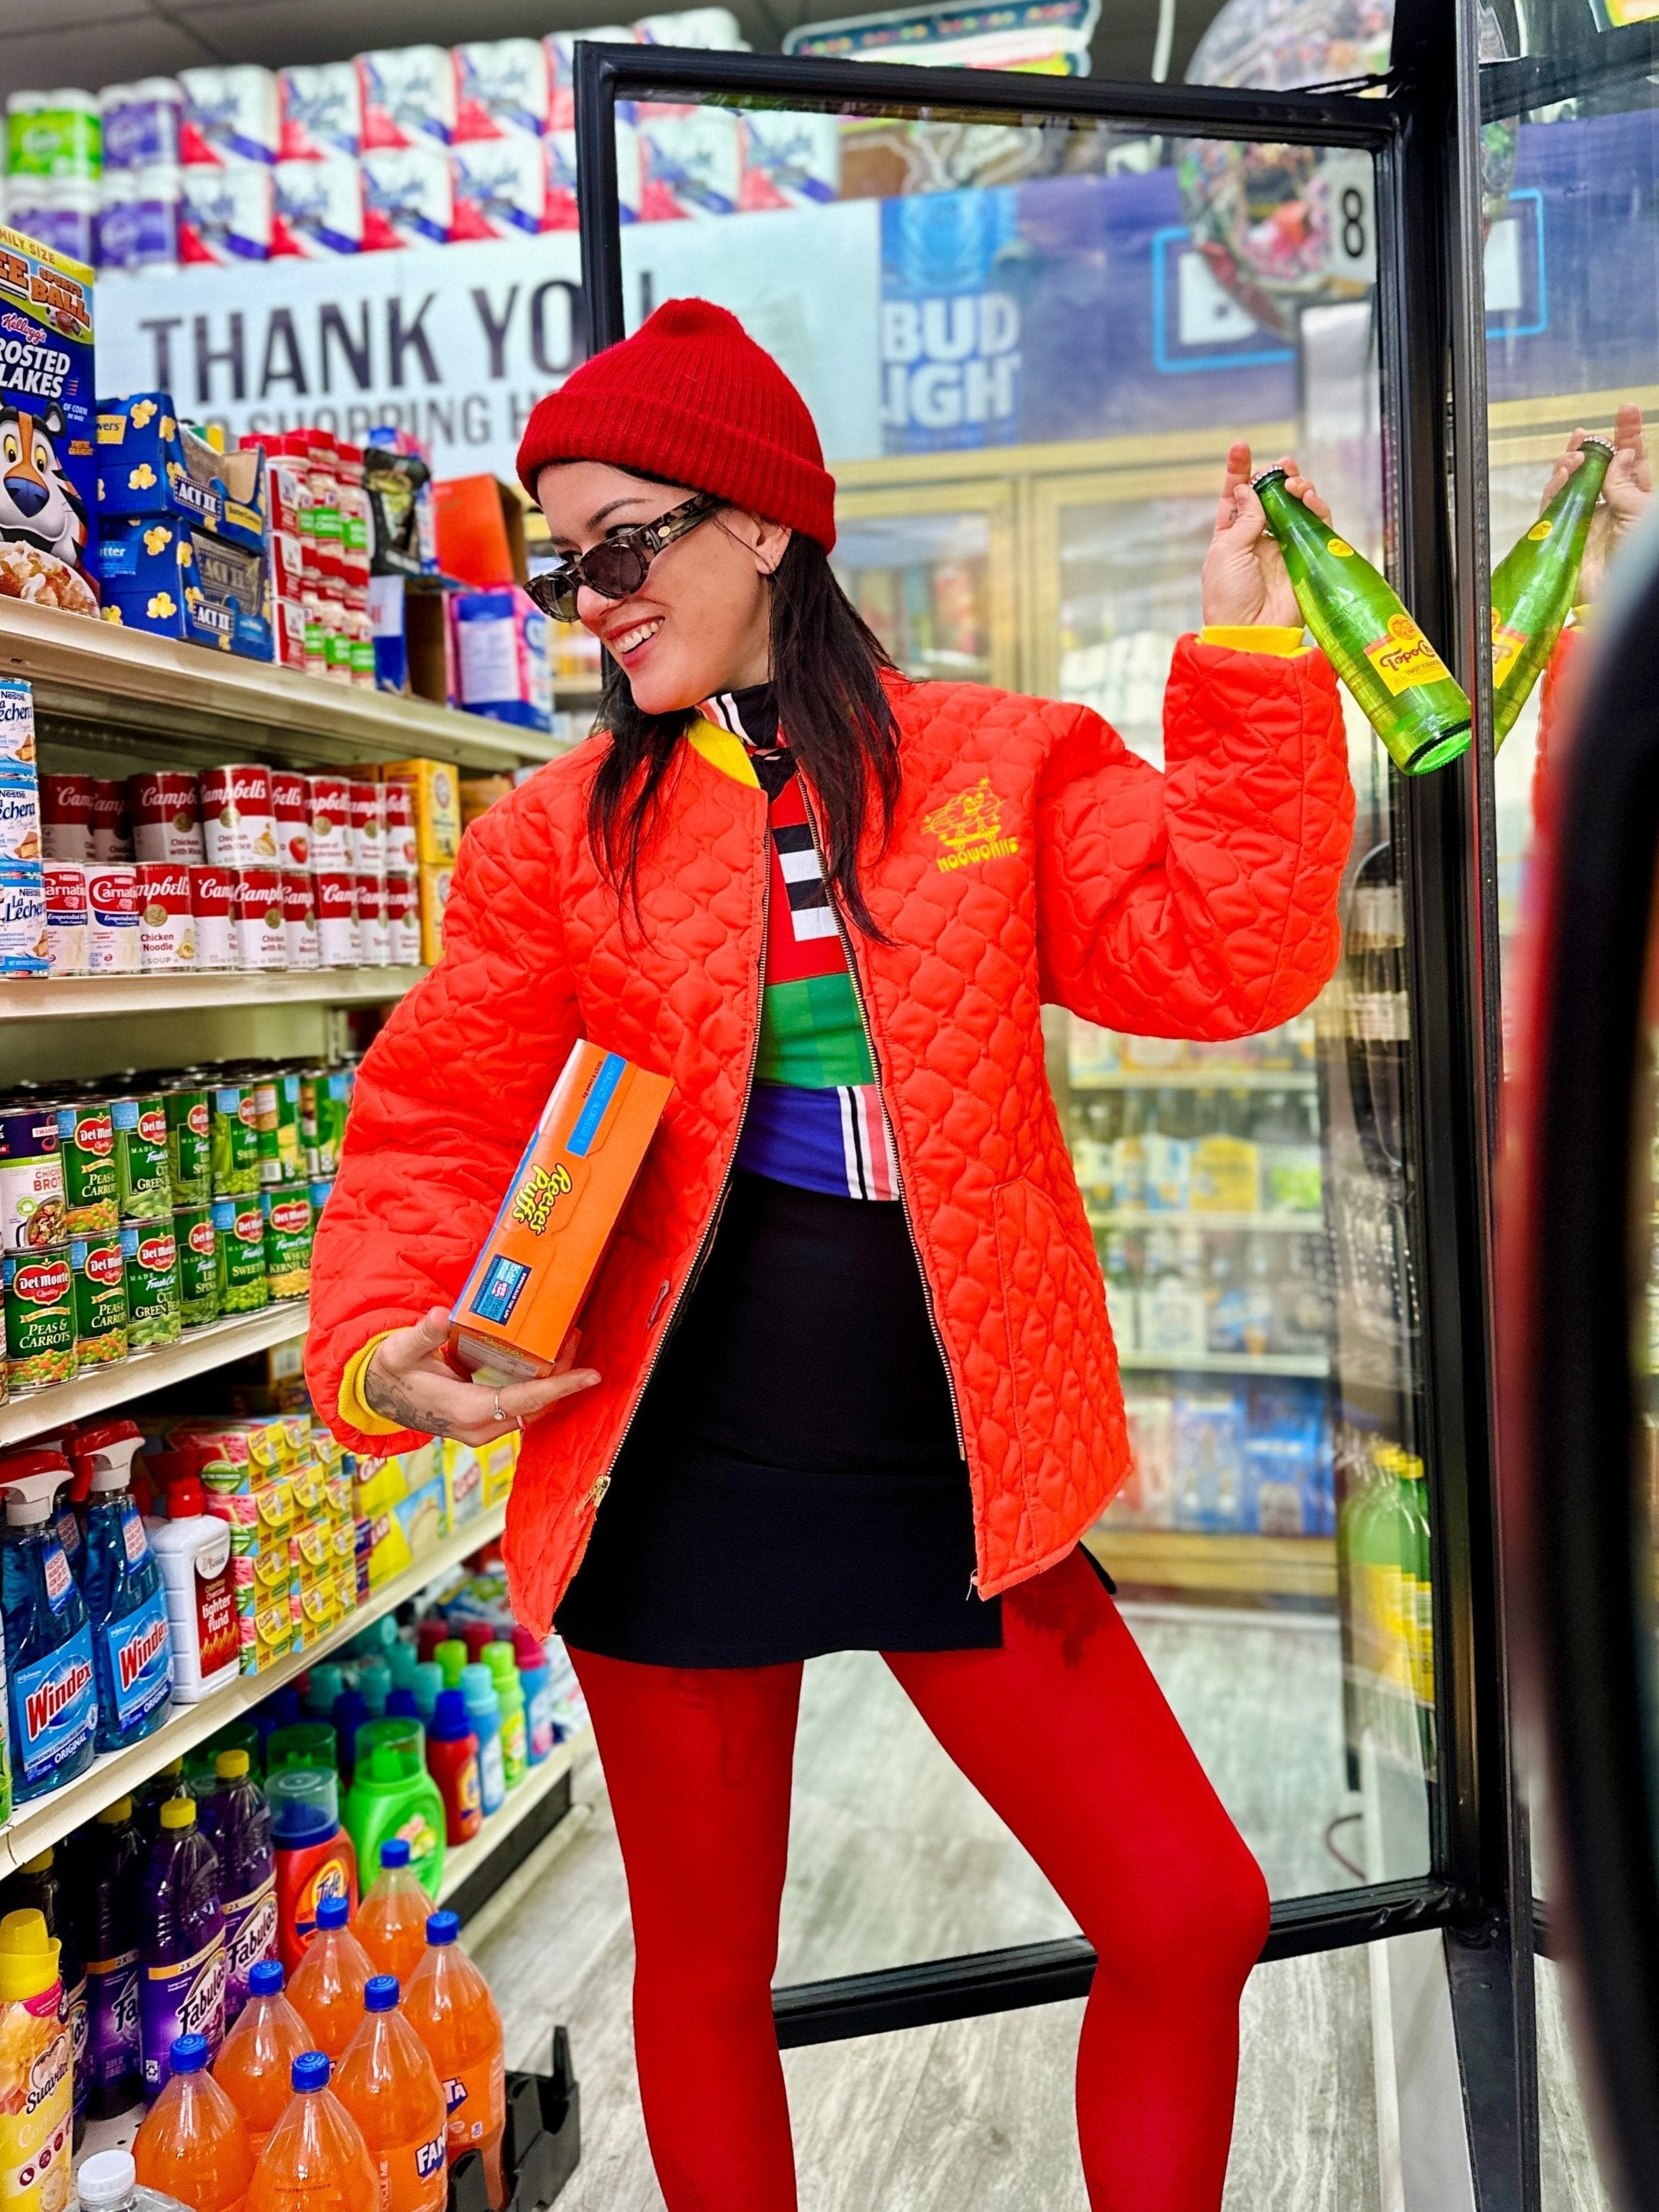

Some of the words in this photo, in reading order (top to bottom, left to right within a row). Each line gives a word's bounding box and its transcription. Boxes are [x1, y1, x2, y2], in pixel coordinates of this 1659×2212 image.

[1342, 189, 1364, 258] 8
[29, 242, 56, 265] SIZE
[30, 276, 90, 329] BALL
[2, 313, 47, 344] Kellogg's
[881, 294, 1020, 361] BUD
[139, 293, 443, 402] THANK
[471, 273, 652, 378] YO
[880, 352, 1021, 428] IGH
[178, 483, 202, 506] ACT
[203, 494, 216, 513] II
[197, 607, 217, 627] ACT
[218, 614, 230, 631] II
[1379, 647, 1419, 672] Topo
[218, 834, 247, 843] Chicen
[169, 847, 188, 855] with
[217, 844, 232, 852] with
[12, 895, 24, 908] La
[140, 934, 174, 942] Chicken
[143, 943, 173, 951] Noodle
[80, 1129, 97, 1141] Del
[142, 1121, 155, 1132] Del
[512, 1163, 550, 1224] Puffs
[529, 1163, 573, 1236] Reese's
[274, 1212, 288, 1223] Del
[238, 1222, 251, 1232] Del
[192, 1233, 205, 1244] Del
[142, 1248, 158, 1260] Del
[90, 1260, 107, 1271] Del
[19, 1277, 39, 1290] Del
[40, 1272, 69, 1287] Monte
[130, 1272, 154, 1282] MADE
[512, 1272, 527, 1300] DOWNLOAD
[99, 1303, 120, 1315] PEAS
[136, 1305, 167, 1318] GREEN
[507, 1300, 515, 1309] THE
[28, 1322, 57, 1336] PEAS
[59, 1318, 67, 1331] &
[20, 1331, 70, 1349] CARROTS
[202, 1594, 232, 1619] lighter
[208, 1609, 230, 1634] fluid
[26, 1661, 93, 1743] Windex
[54, 1731, 88, 1764] ORIGINAL
[317, 1873, 342, 1901] Tide
[227, 1903, 240, 1912] 2X
[116, 1957, 128, 1966] 2X
[180, 1962, 191, 1972] 2X
[415, 2122, 447, 2174] FAN
[380, 2160, 389, 2177] ME
